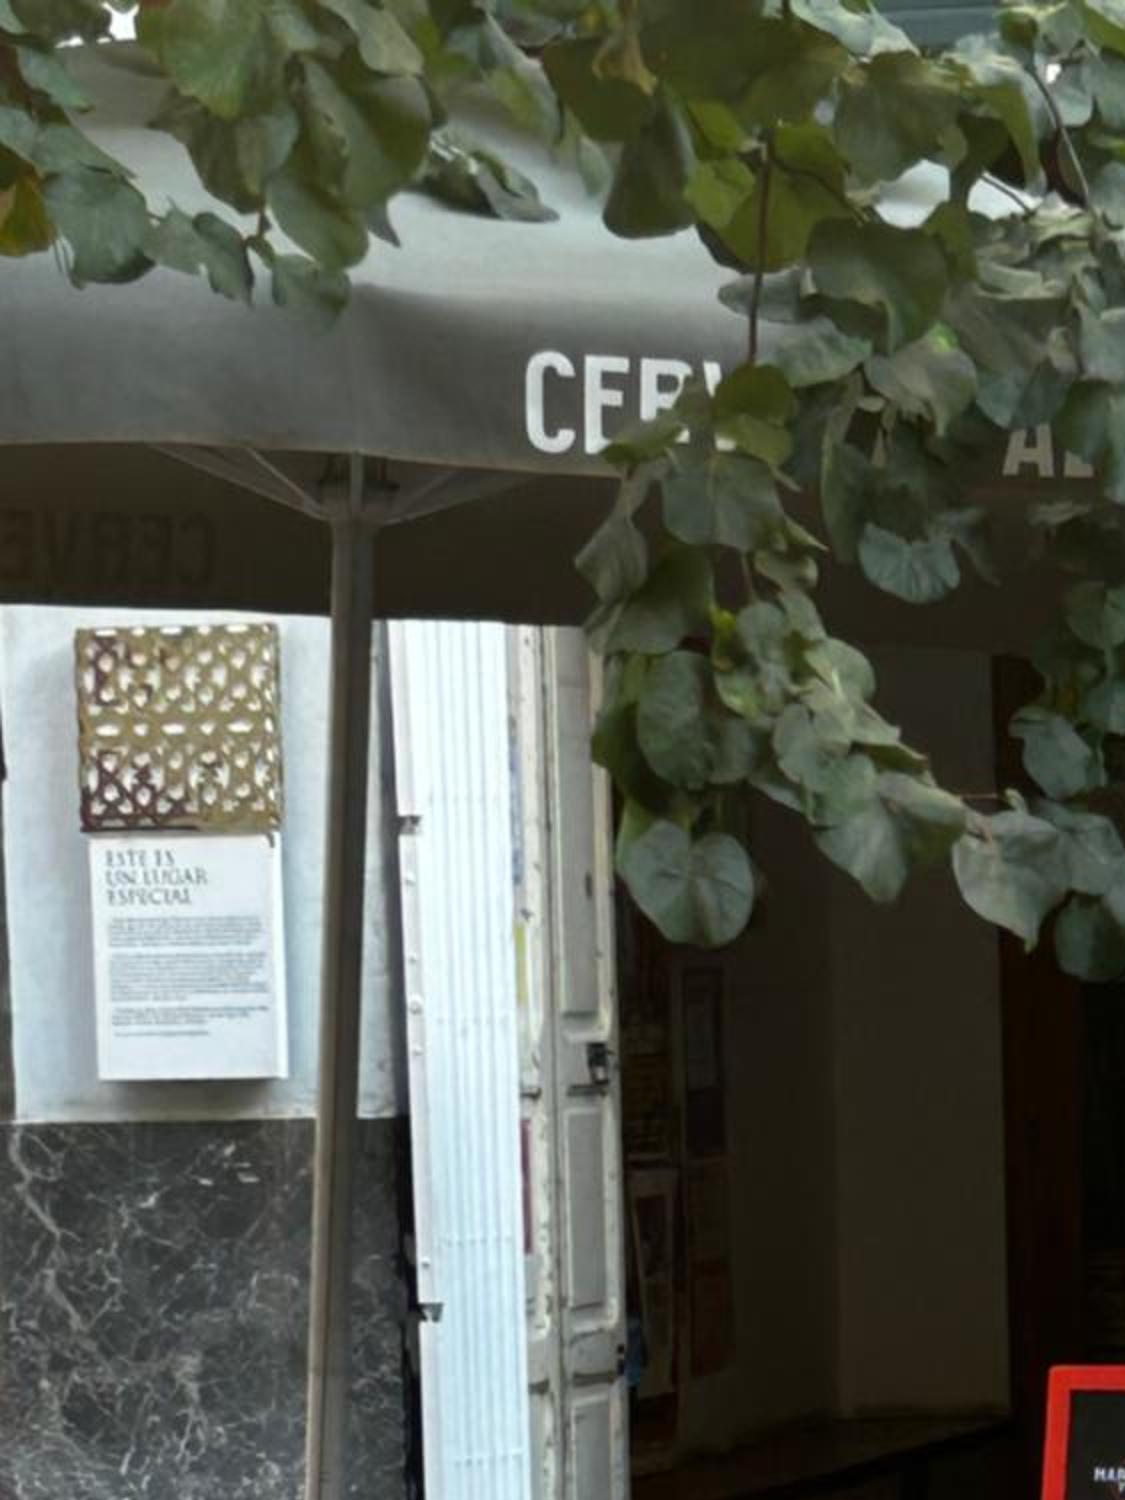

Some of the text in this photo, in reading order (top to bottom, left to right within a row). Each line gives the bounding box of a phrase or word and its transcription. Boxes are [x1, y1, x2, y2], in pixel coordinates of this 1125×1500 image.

[105, 849, 176, 867] ESTE ES
[104, 866, 209, 888] UN LUGAR
[106, 888, 193, 906] ESPECIAL
